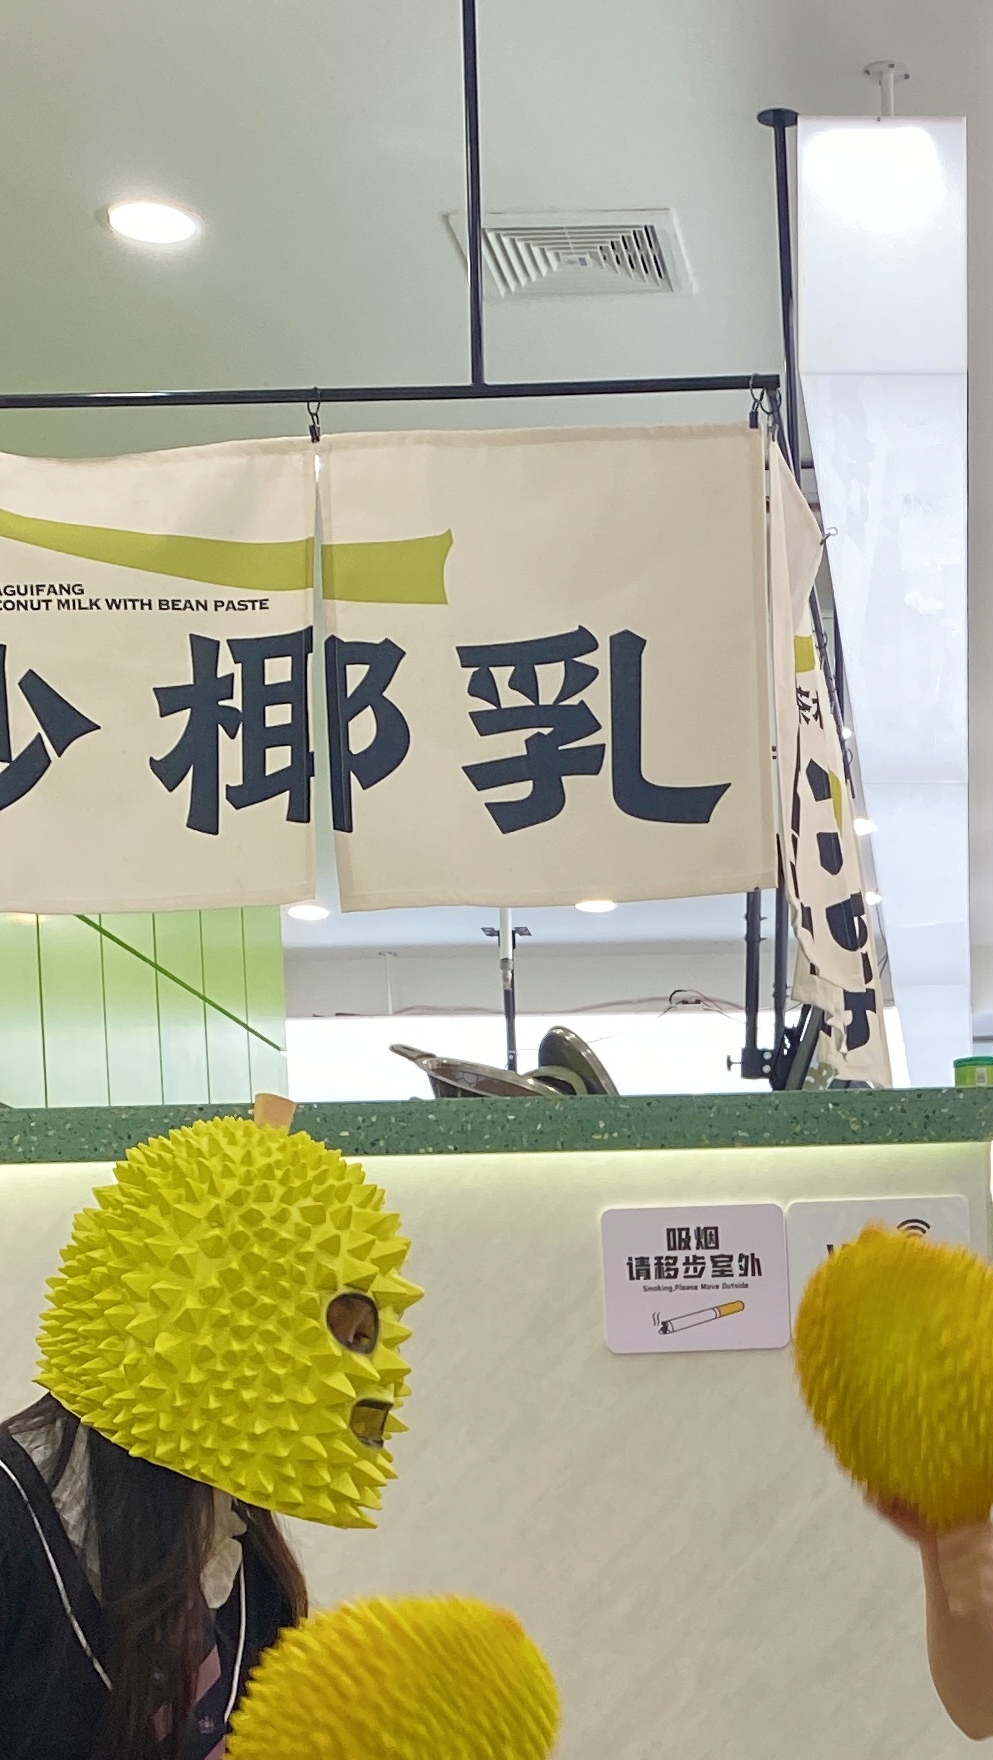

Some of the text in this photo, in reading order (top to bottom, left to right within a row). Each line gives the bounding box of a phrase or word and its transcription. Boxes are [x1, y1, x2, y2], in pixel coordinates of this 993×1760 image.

[57, 598, 101, 611] MILK
[105, 598, 152, 611] WITH
[158, 599, 209, 612] BEAN
[214, 598, 270, 612] PASTE
[666, 1226, 720, 1251] 吸烟
[626, 1253, 763, 1281] 请移步室外
[700, 1282, 720, 1291] Move
